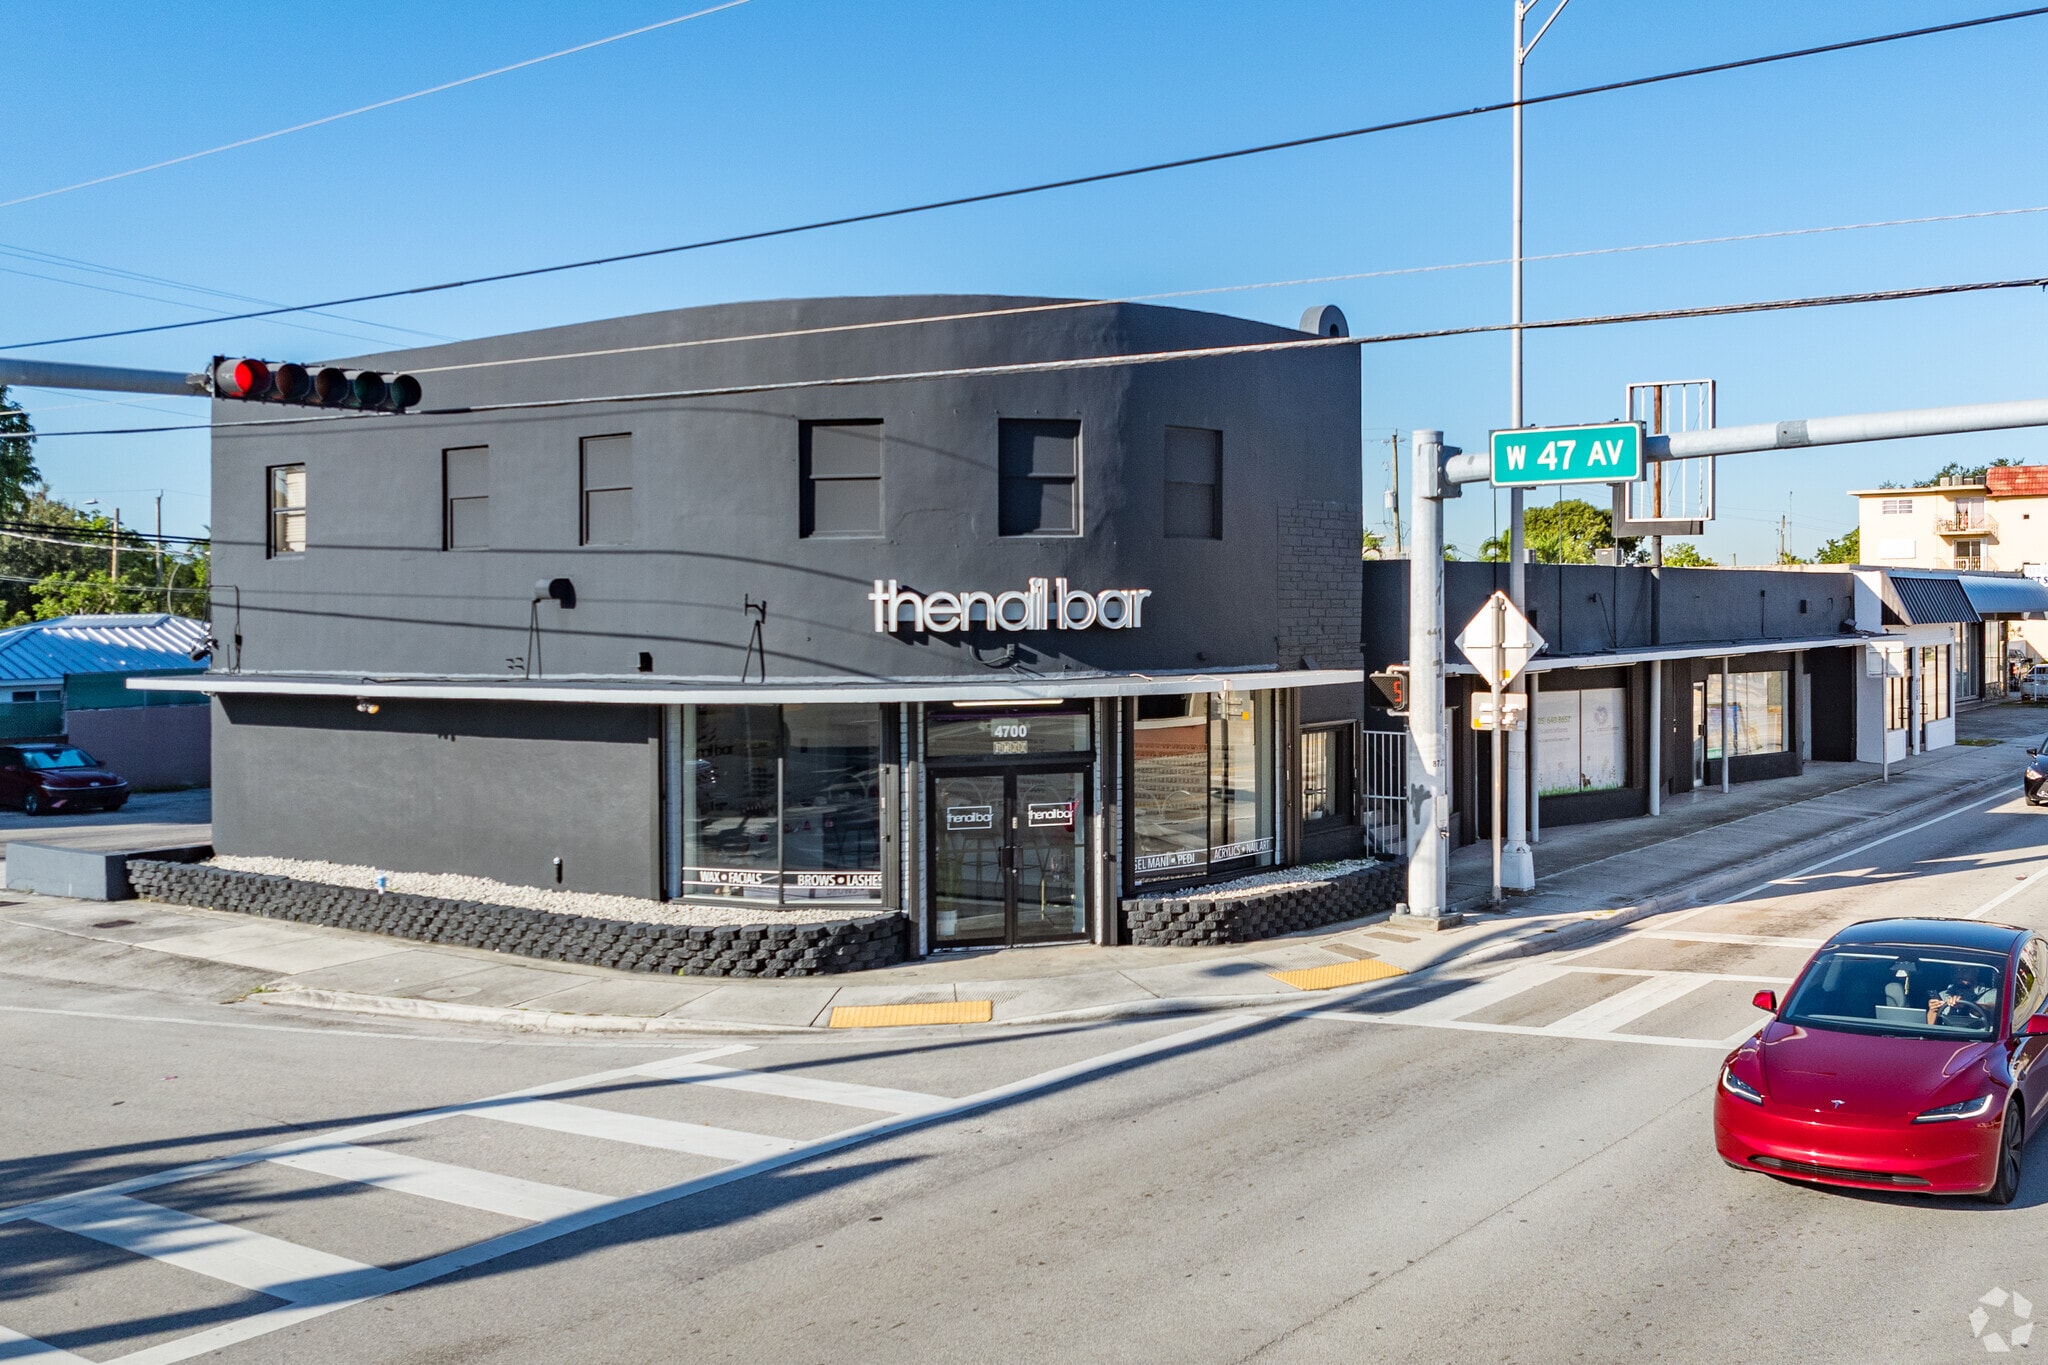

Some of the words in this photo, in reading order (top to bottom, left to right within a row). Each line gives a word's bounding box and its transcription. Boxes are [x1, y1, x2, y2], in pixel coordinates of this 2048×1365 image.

[1506, 444, 1526, 471] W
[1537, 439, 1576, 471] 47
[1587, 439, 1624, 467] AV
[994, 725, 1027, 738] 4700
[1214, 844, 1241, 860] ACRYLICS
[1246, 842, 1258, 854] NAIL
[1258, 840, 1270, 851] ART
[1147, 856, 1169, 869] MANI
[1177, 853, 1195, 865] PEDI
[700, 871, 720, 883] WAX
[728, 872, 762, 885] FACIALS
[797, 875, 836, 886] BROWS
